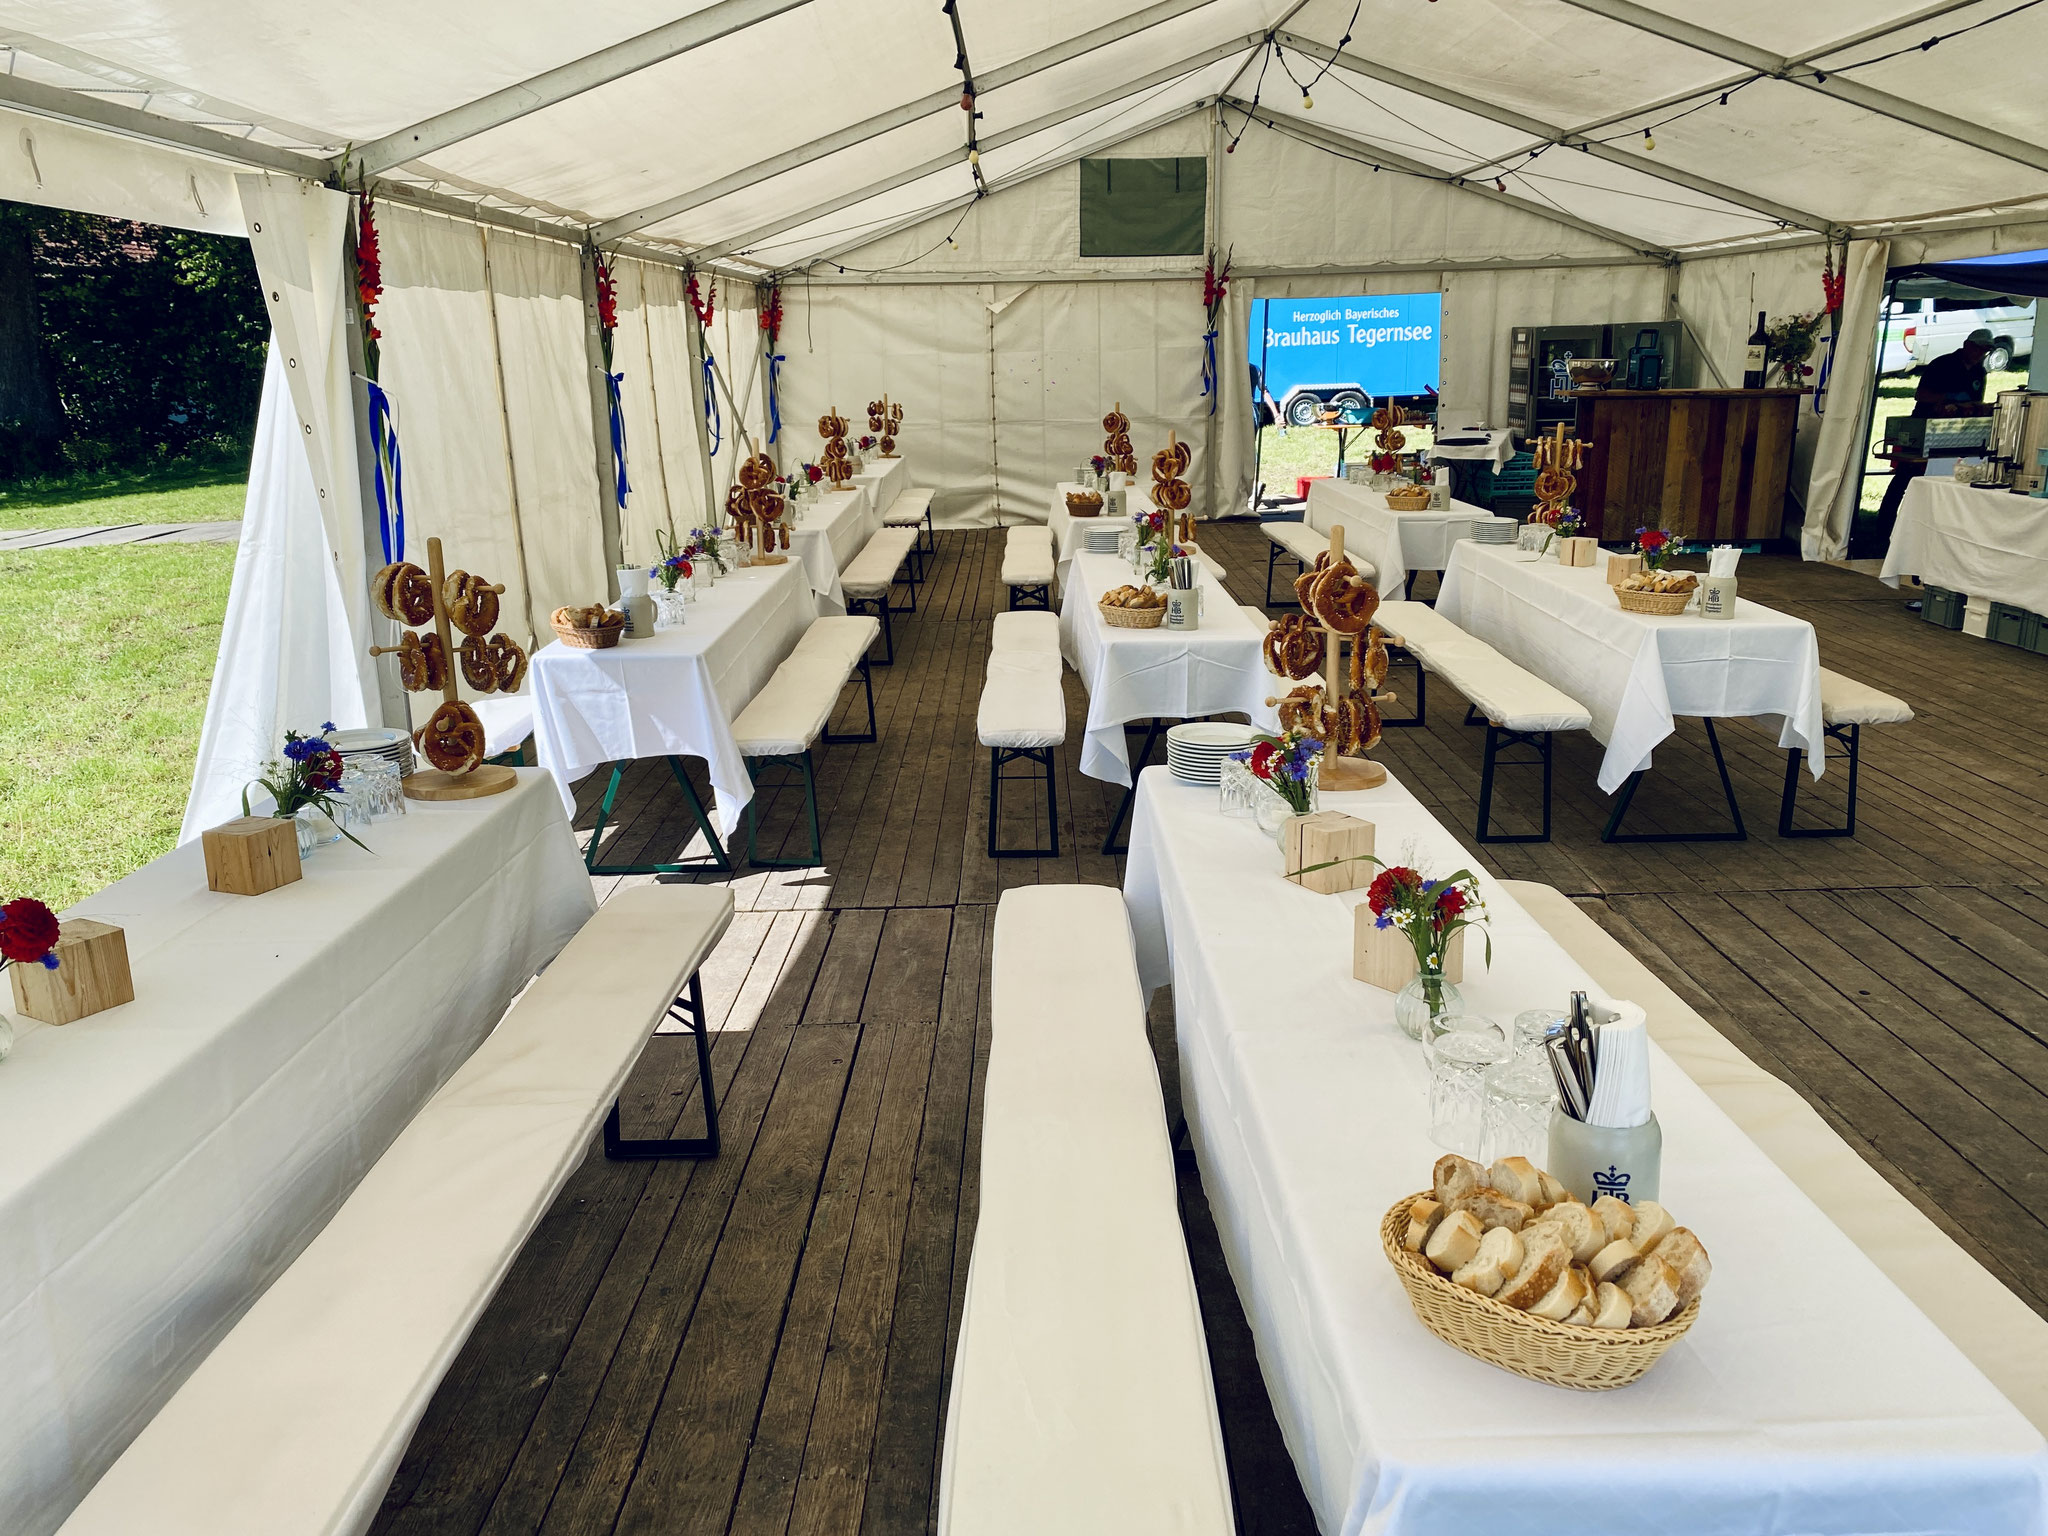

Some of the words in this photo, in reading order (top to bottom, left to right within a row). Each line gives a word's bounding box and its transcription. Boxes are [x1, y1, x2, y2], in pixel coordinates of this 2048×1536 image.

[1293, 309, 1342, 324] Herzoglich
[1345, 307, 1400, 322] Bayerisches
[1264, 326, 1340, 348] Brauhaus
[1347, 323, 1433, 348] Tegernsee
